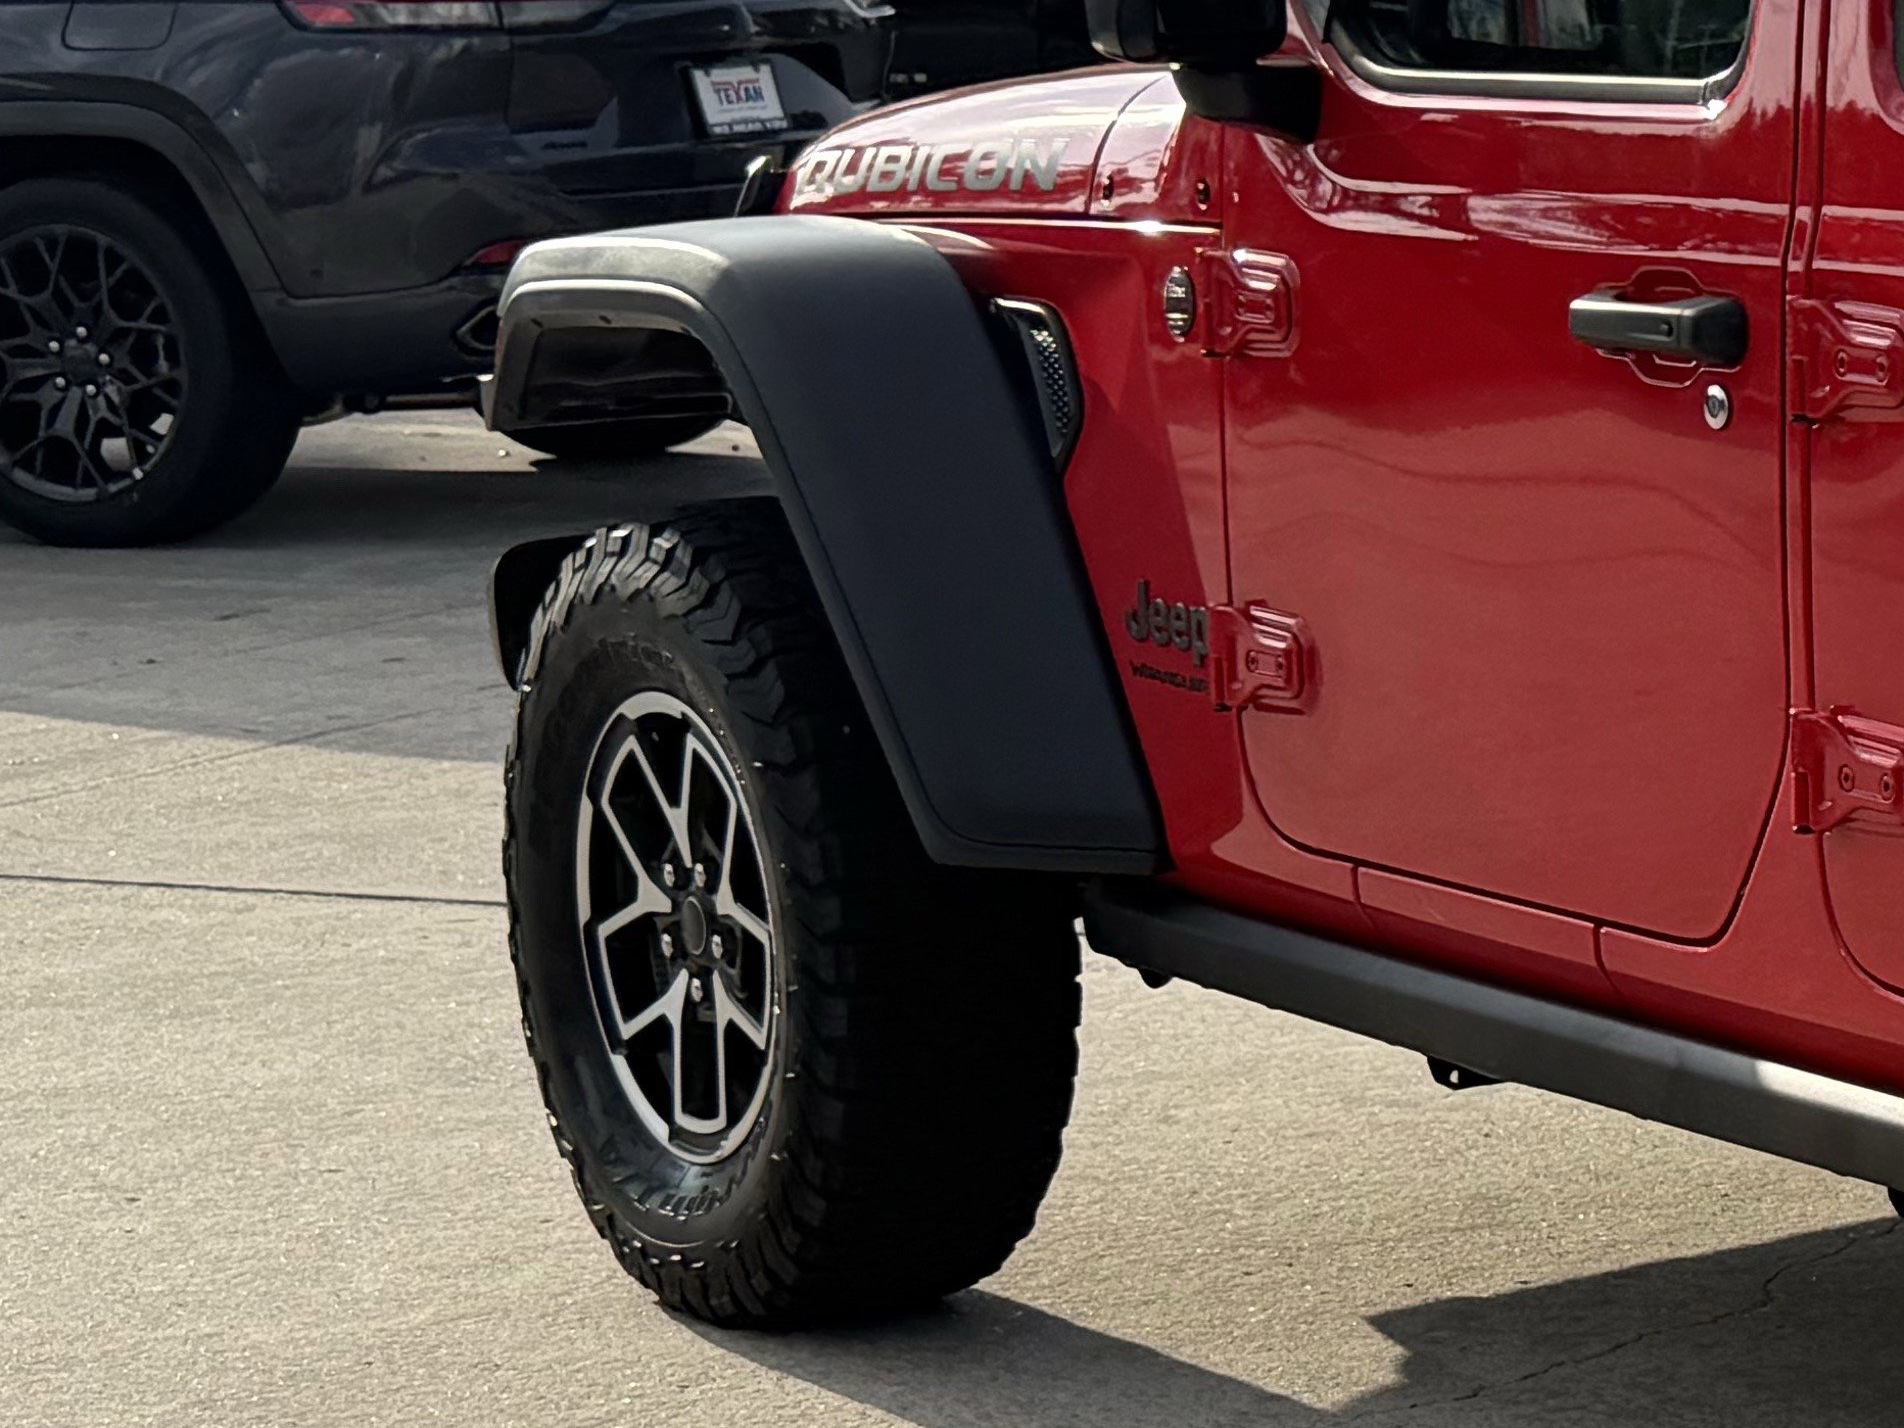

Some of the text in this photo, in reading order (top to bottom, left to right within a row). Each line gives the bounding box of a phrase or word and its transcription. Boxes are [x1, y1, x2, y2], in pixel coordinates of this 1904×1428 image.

[711, 78, 766, 106] TEXAN
[801, 137, 1069, 193] RUBICON
[1125, 579, 1209, 668] Jeep
